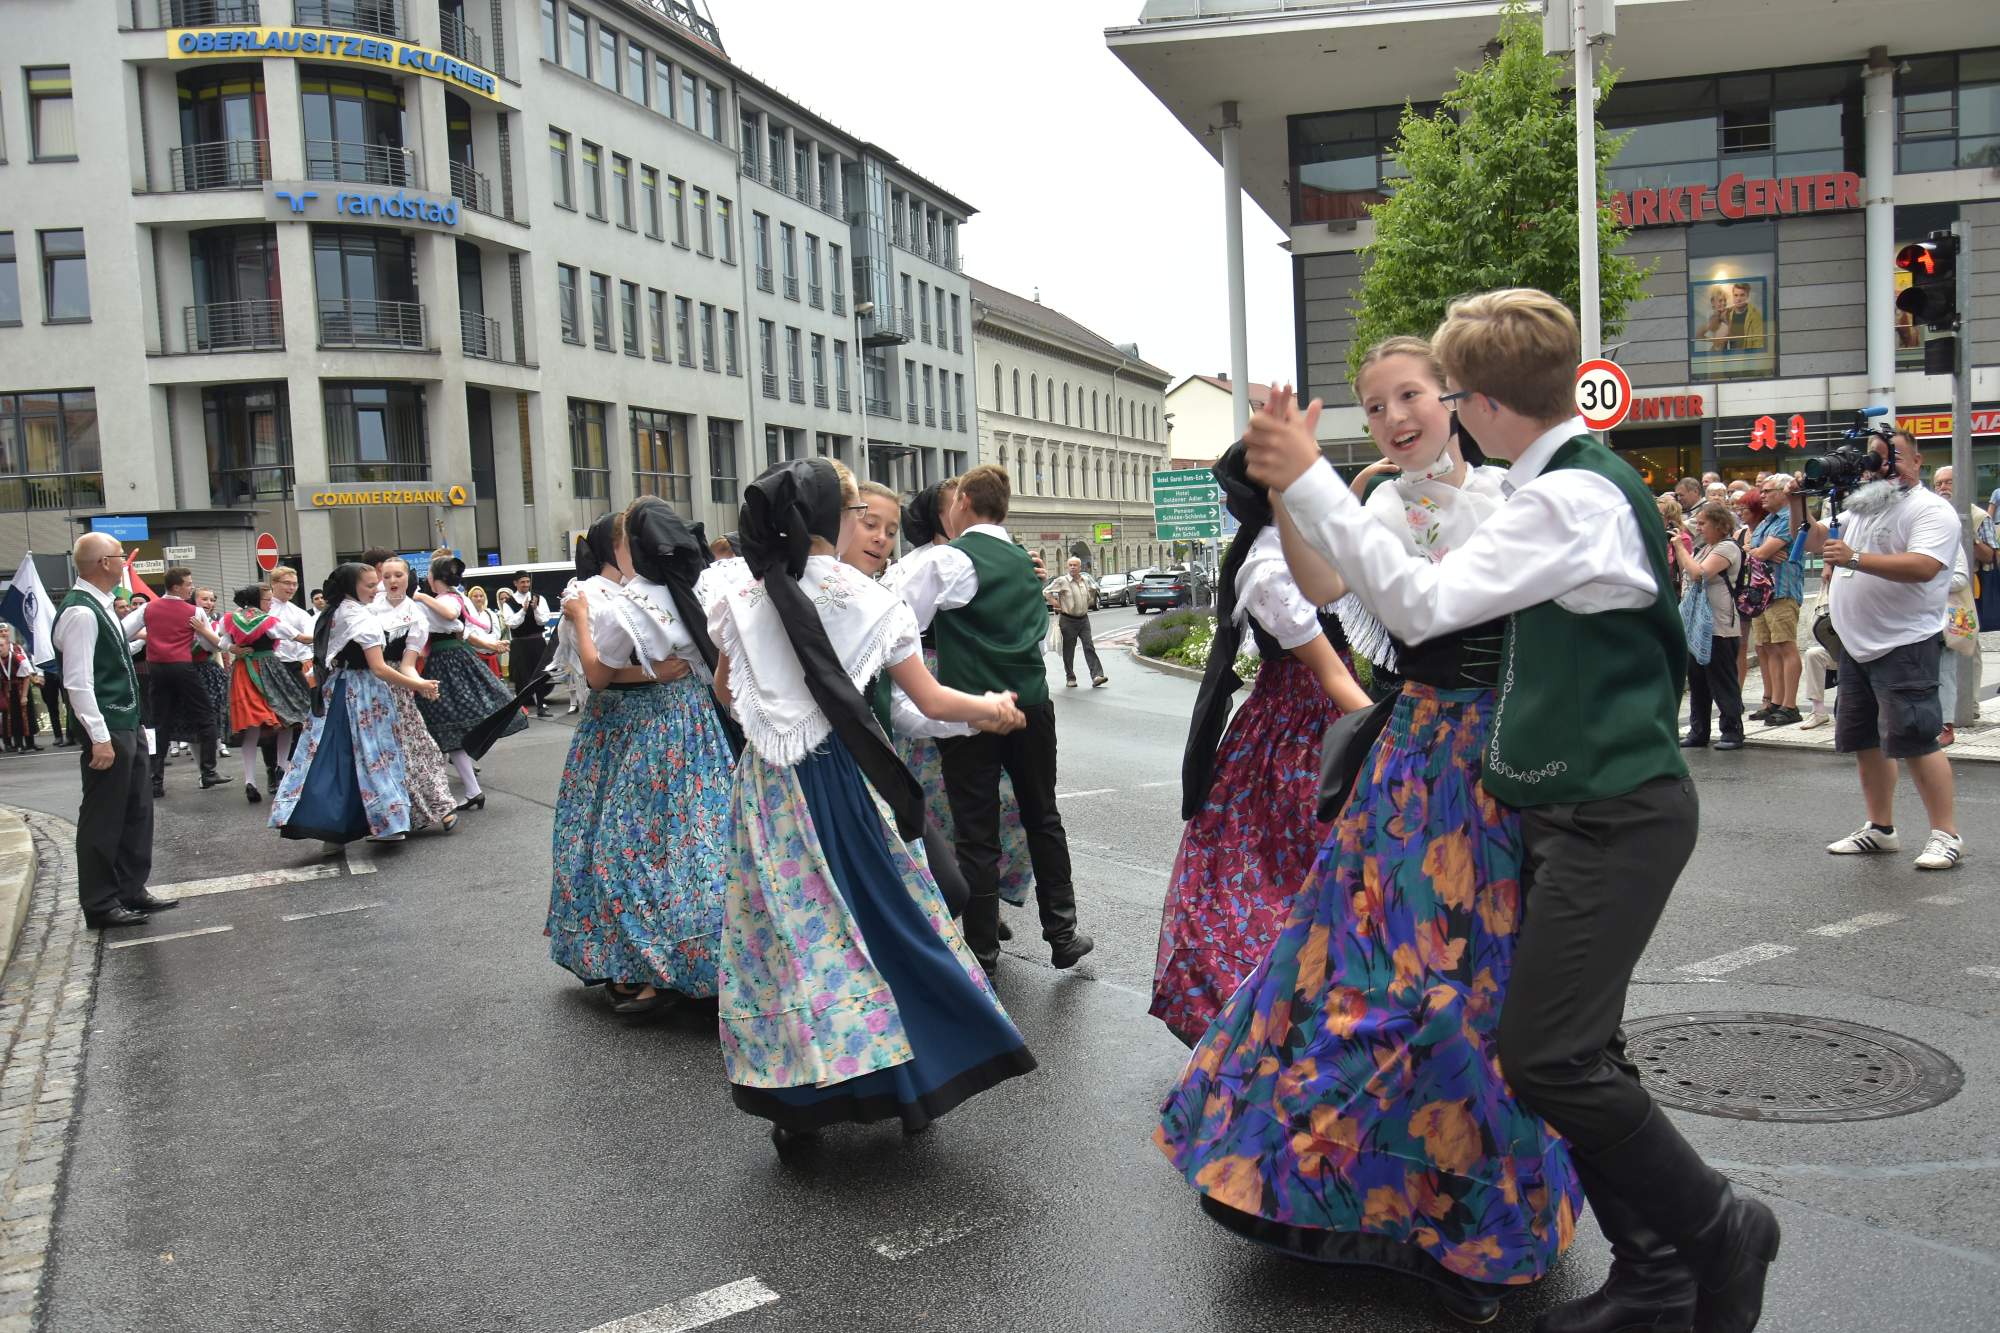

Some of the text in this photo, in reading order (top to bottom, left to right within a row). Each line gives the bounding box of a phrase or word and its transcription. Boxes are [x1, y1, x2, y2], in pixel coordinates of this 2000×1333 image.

[178, 31, 496, 95] OBERLAUSITZER KURIER
[337, 191, 459, 225] randstad
[1602, 172, 1861, 225] ARKT-CENTER
[1580, 379, 1617, 411] 30
[1626, 395, 1704, 421] ENTER
[312, 491, 445, 506] COMMERZBANK
